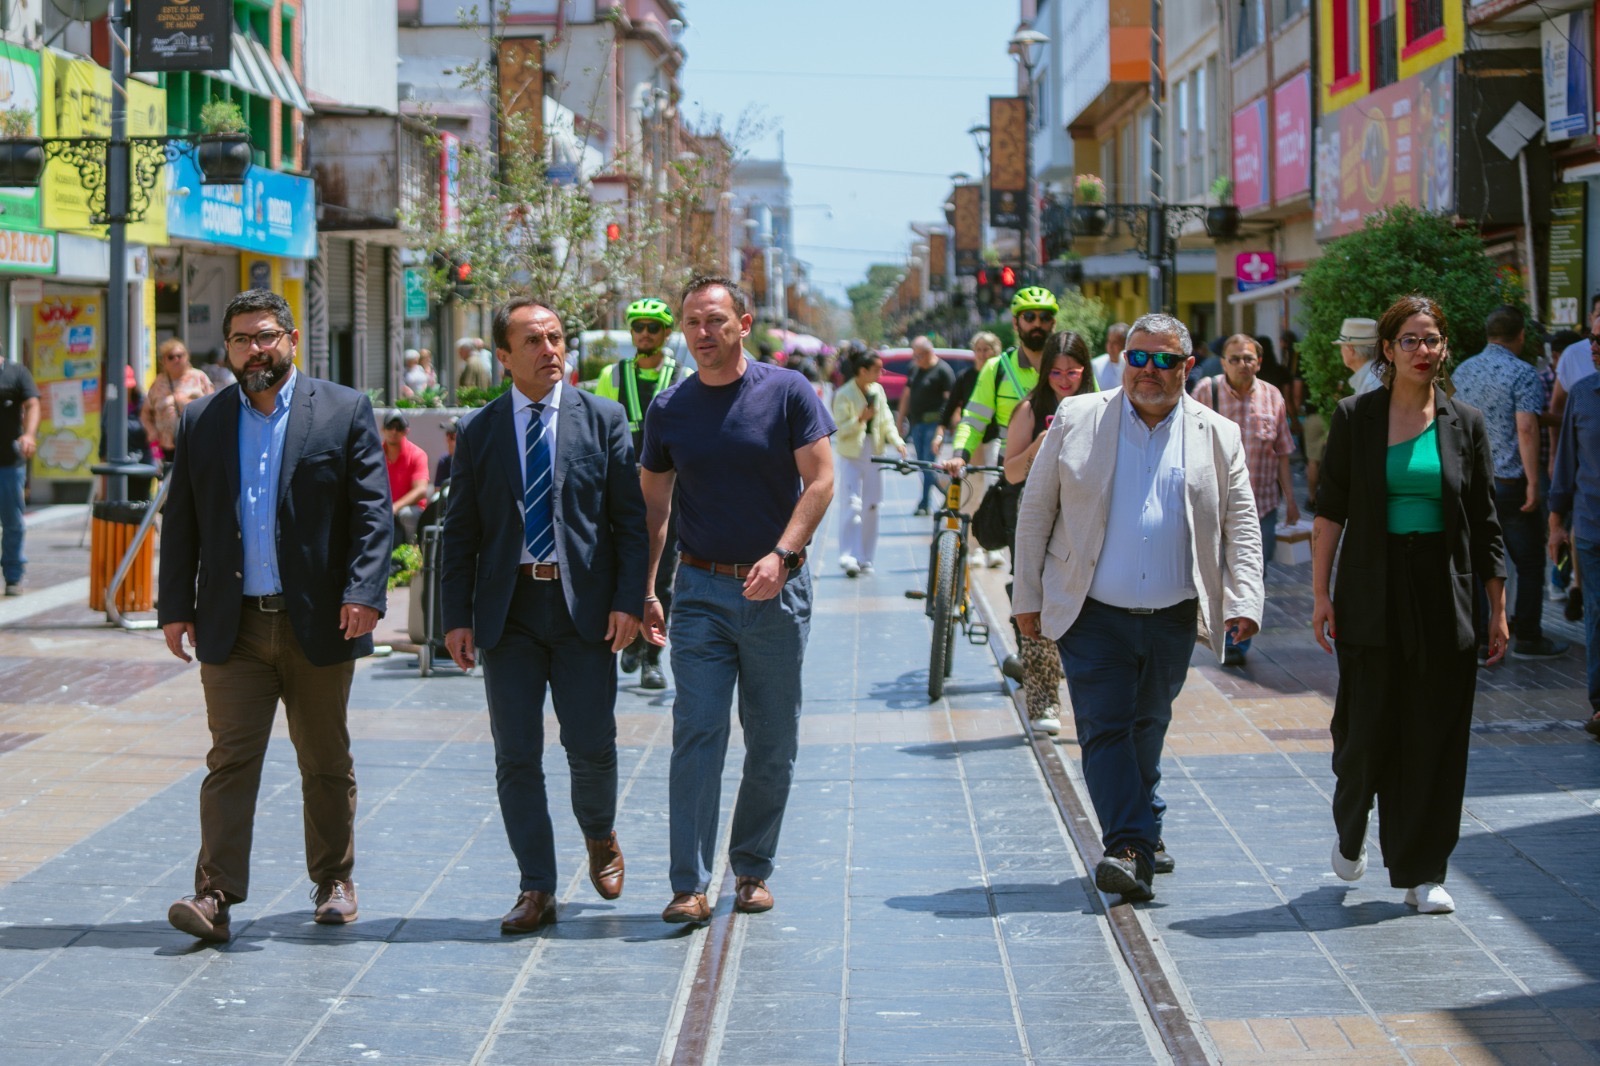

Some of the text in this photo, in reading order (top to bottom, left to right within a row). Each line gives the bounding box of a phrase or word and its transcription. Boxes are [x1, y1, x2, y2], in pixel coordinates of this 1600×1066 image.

[190, 5, 200, 13] UN
[157, 13, 185, 21] ESPACIO
[165, 21, 174, 29] DE
[201, 199, 243, 236] COQUIMBO
